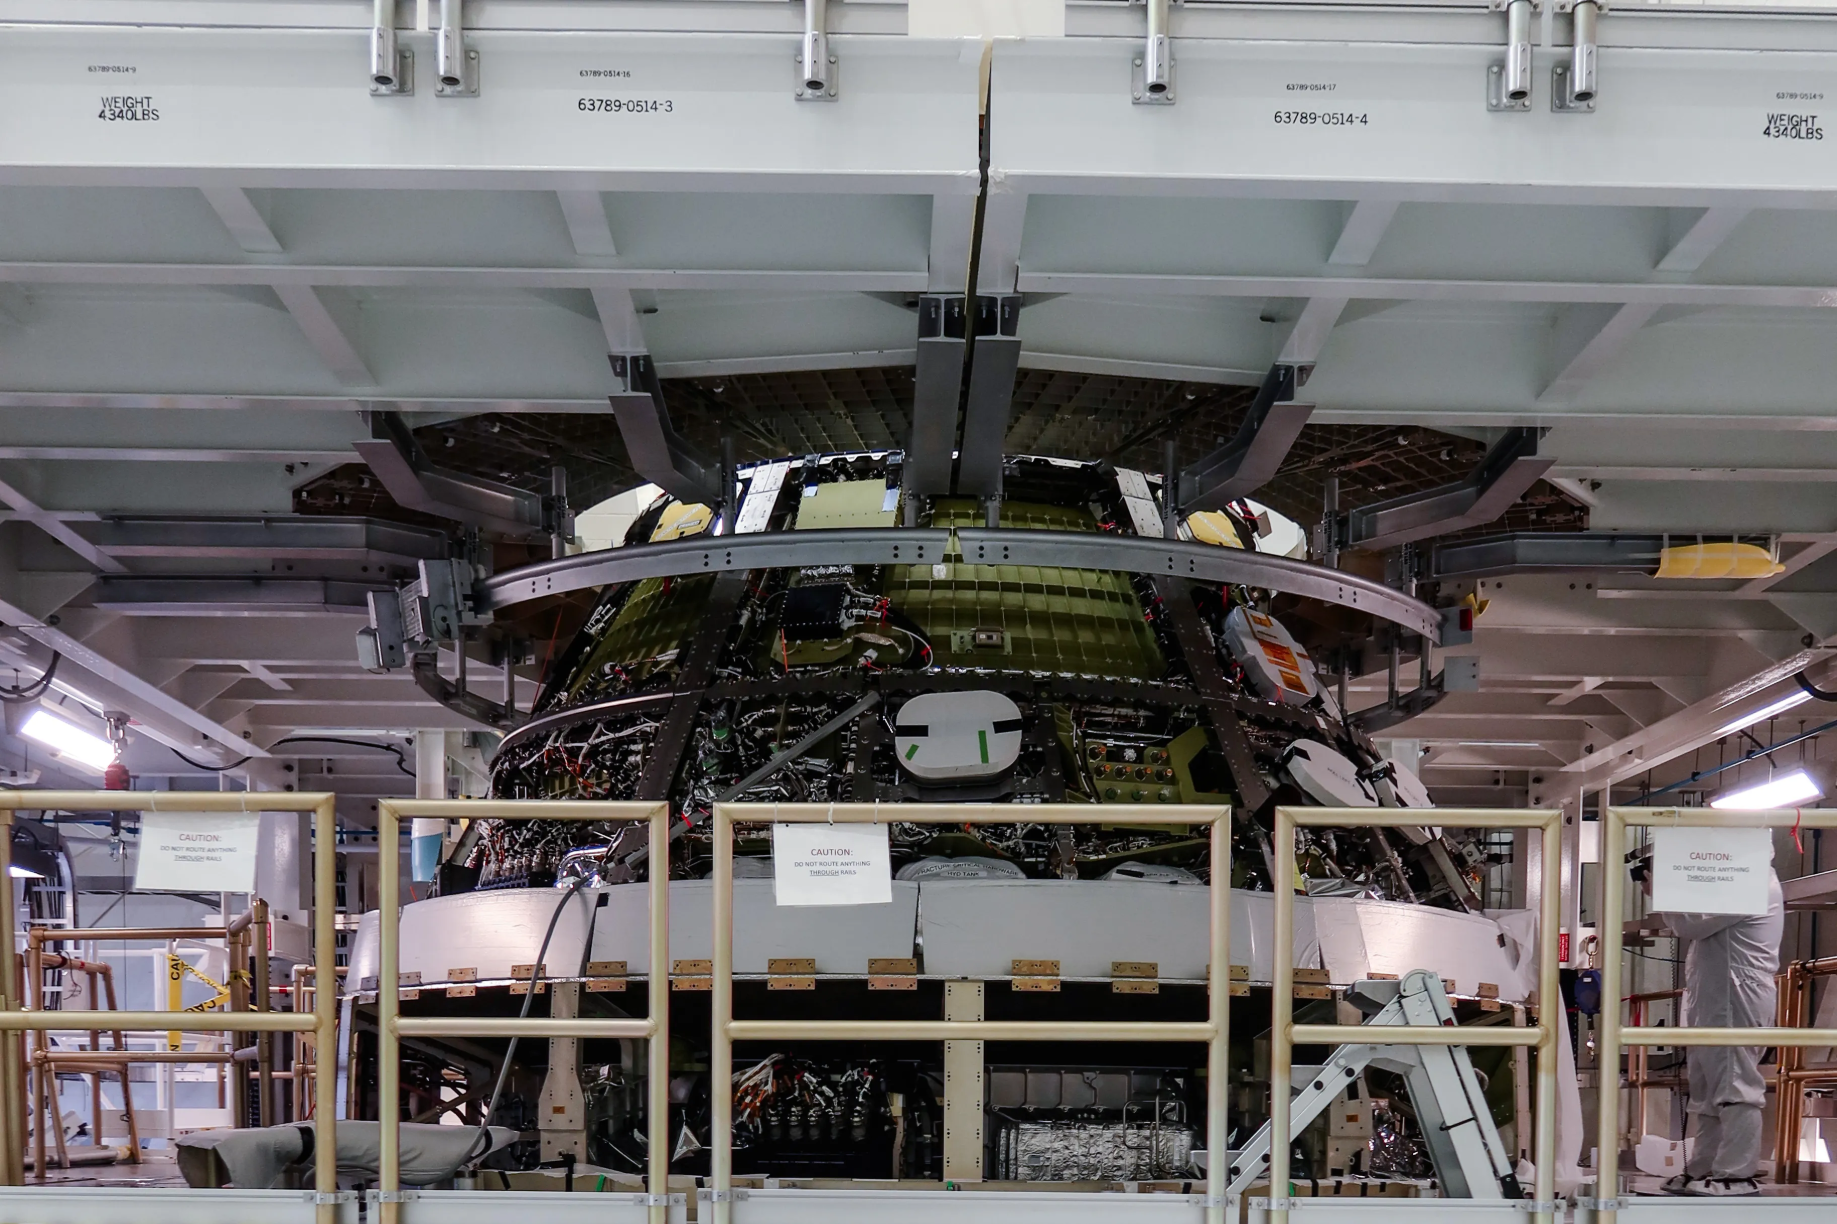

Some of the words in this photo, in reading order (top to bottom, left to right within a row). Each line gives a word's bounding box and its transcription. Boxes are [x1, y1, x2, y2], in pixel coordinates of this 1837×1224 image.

[580, 70, 631, 78] 63789-0514-16
[101, 96, 152, 109] WEIGHT
[578, 98, 673, 113] 63789-0514-3
[98, 108, 160, 121] 4340LBS
[1274, 111, 1368, 125] 63789-0514-4
[1767, 113, 1818, 127] WEIGHT
[1763, 126, 1824, 140] 4340LBS
[179, 833, 222, 842] CAUTION:
[174, 854, 204, 862] THROUGH
[1689, 852, 1733, 861] CAUTION:
[1687, 874, 1716, 882] THROUGH
